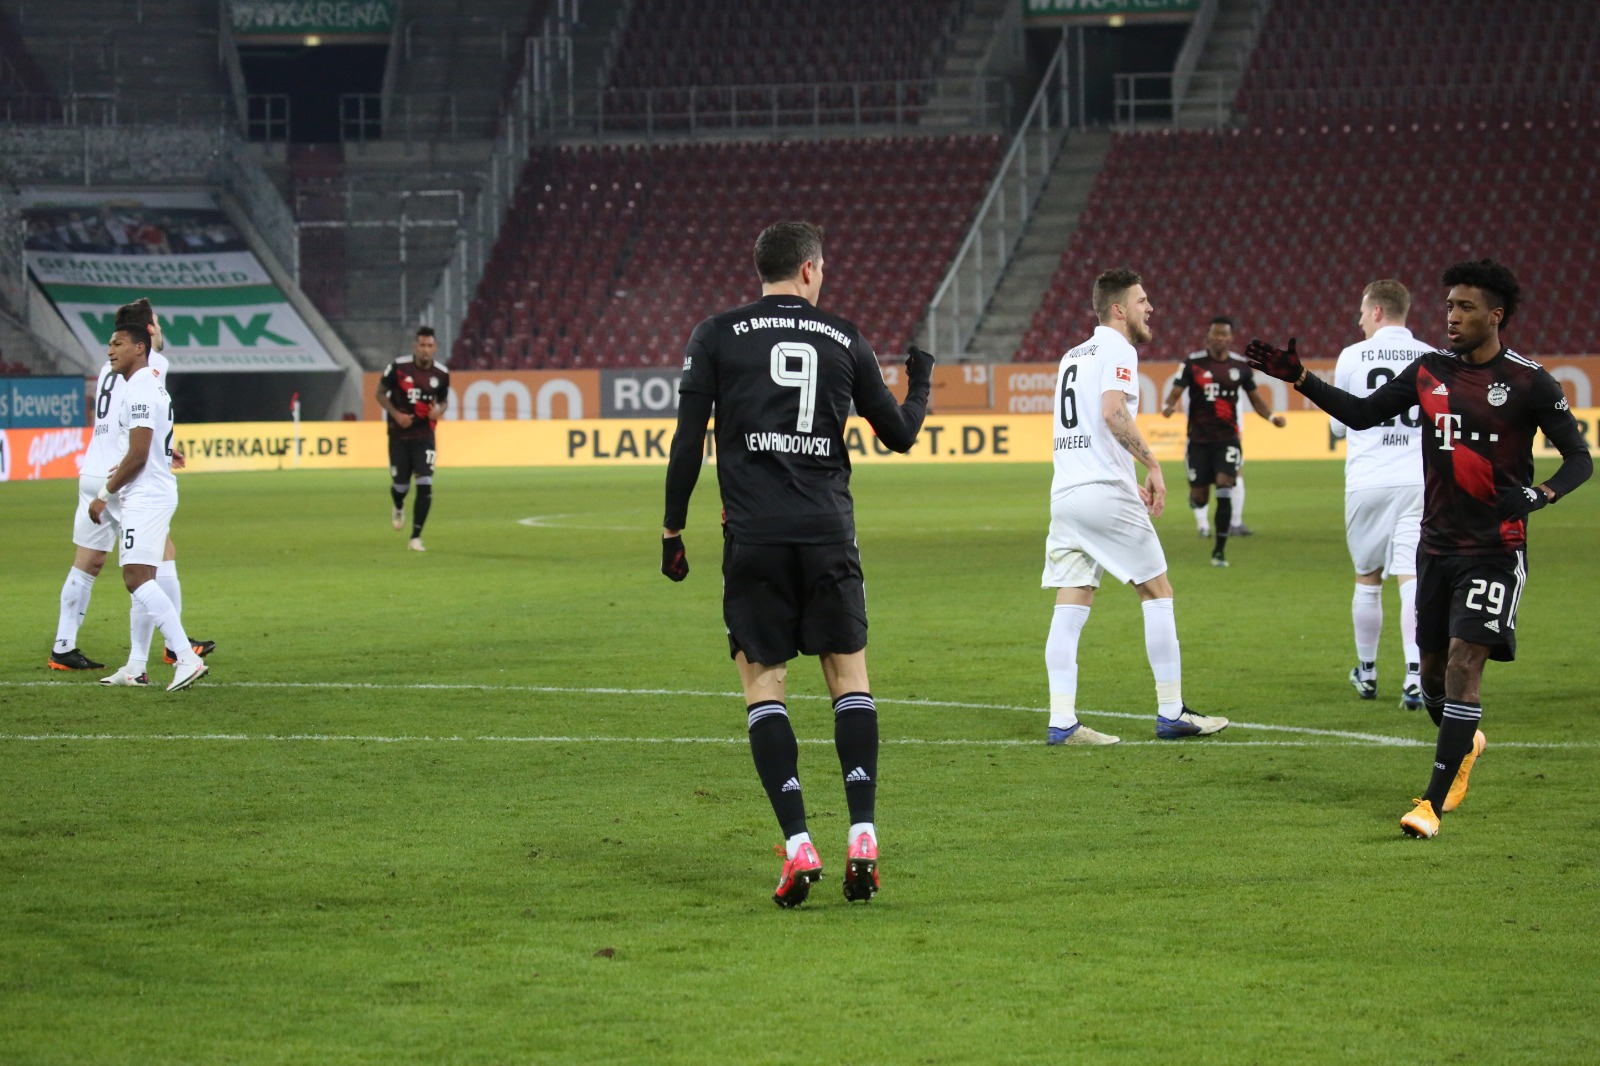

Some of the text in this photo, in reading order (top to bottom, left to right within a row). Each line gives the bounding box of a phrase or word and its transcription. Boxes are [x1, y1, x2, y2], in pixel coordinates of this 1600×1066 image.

[37, 257, 218, 273] GEMEINSCHAFT
[88, 270, 249, 285] UNTERSCHIED
[733, 317, 852, 349] FC BAYERN MÜNCHEN
[1361, 350, 1375, 362] FC
[962, 365, 987, 385] 13
[97, 371, 118, 419] 8
[770, 341, 818, 433] 9
[1060, 364, 1079, 429] 6
[13, 386, 80, 426] bewegt
[131, 403, 150, 413] sieg-
[131, 411, 150, 420] mund
[176, 436, 348, 459] AT-VERKAUFT.DE
[1382, 434, 1410, 447] HAHN
[124, 528, 136, 549] 5
[1465, 579, 1506, 616] 29
